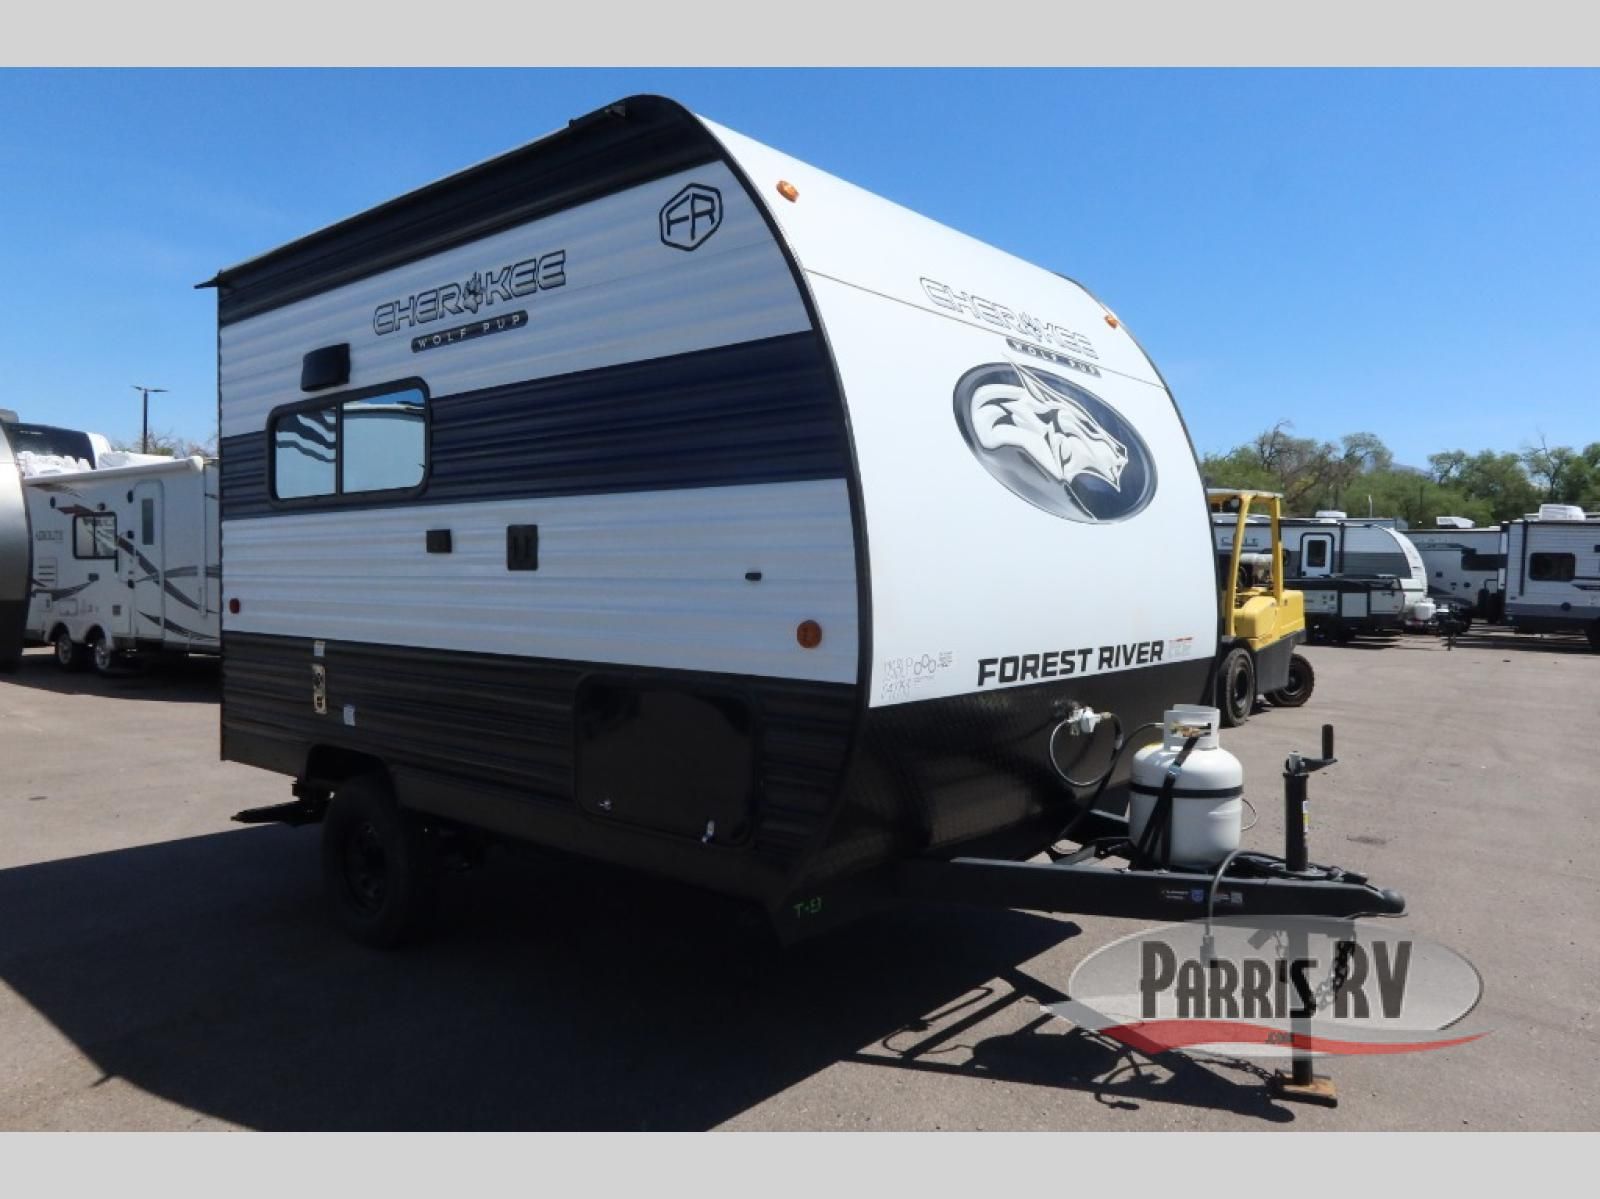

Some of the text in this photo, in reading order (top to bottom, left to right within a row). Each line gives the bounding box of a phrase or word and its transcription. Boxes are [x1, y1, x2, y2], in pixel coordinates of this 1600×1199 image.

[418, 313, 520, 349] WOLF PUP
[977, 648, 1093, 687] FOREST
[1098, 640, 1164, 671] RIVER
